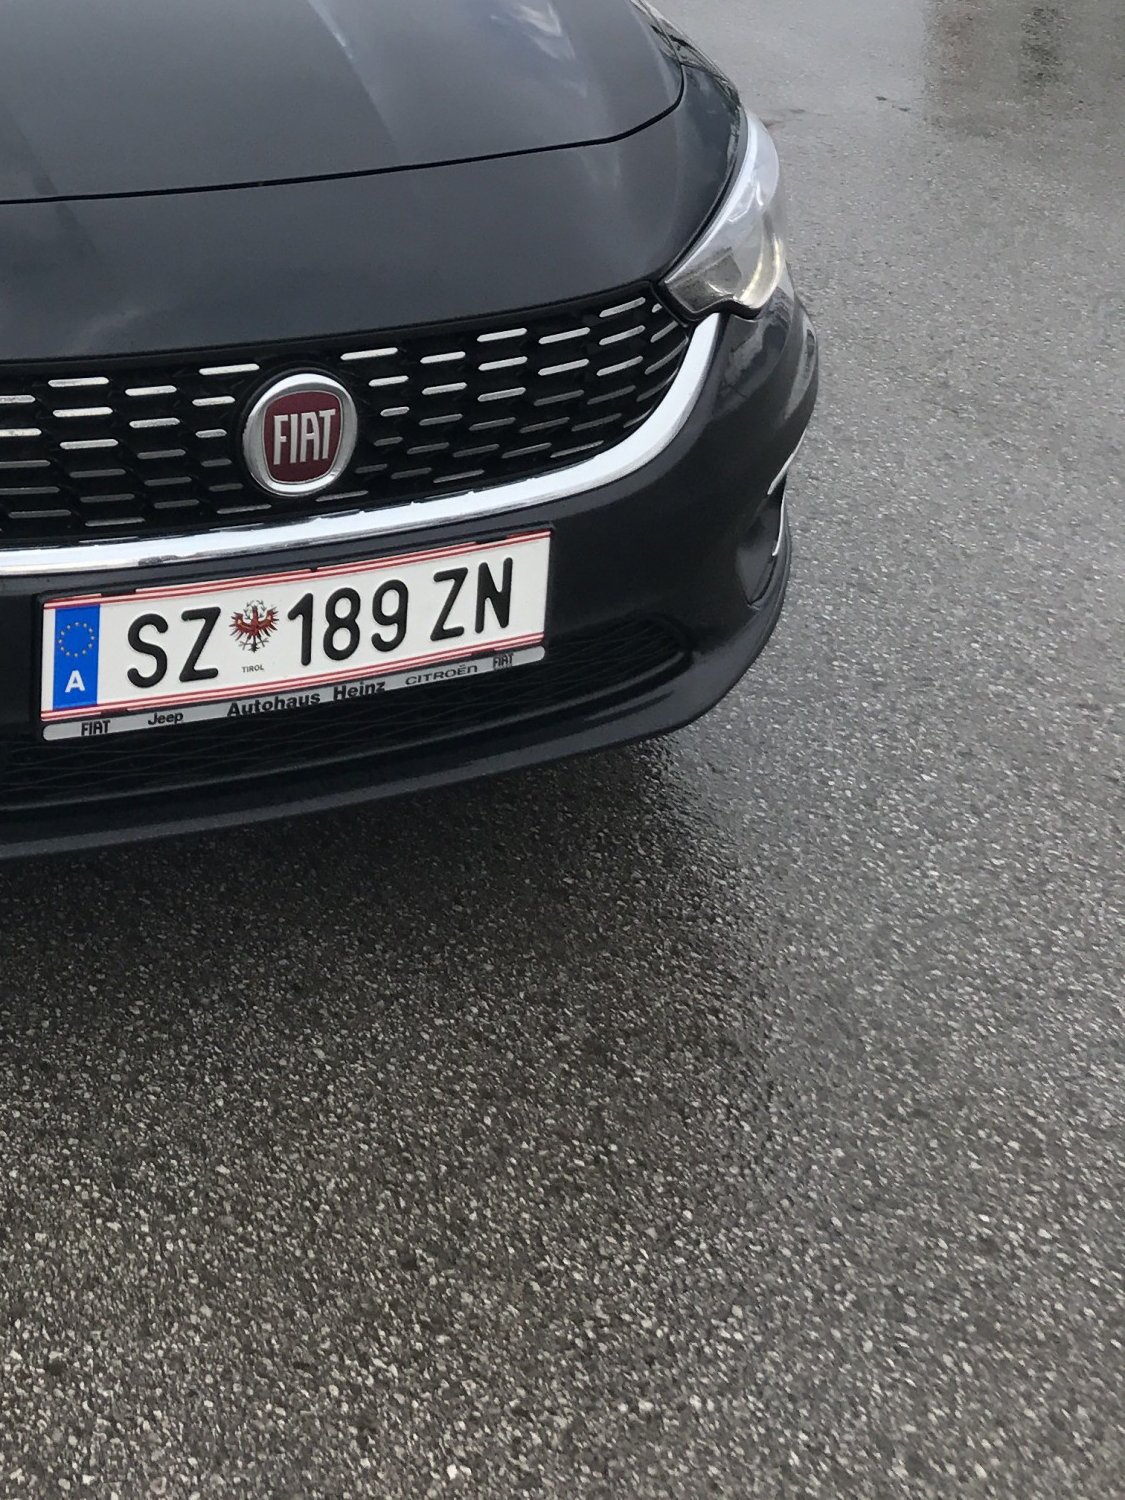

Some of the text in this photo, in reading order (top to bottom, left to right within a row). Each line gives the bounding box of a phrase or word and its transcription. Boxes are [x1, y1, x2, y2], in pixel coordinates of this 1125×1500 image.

[273, 408, 337, 466] FIAT
[127, 557, 514, 688] SZ 189 ZN
[64, 669, 86, 693] A
[80, 719, 111, 737] FIAT
[147, 711, 184, 726] Jeep
[227, 690, 321, 718] Autohaus
[333, 680, 386, 701] Heinz
[492, 652, 514, 669] FIAT
[241, 663, 265, 674] TIROL
